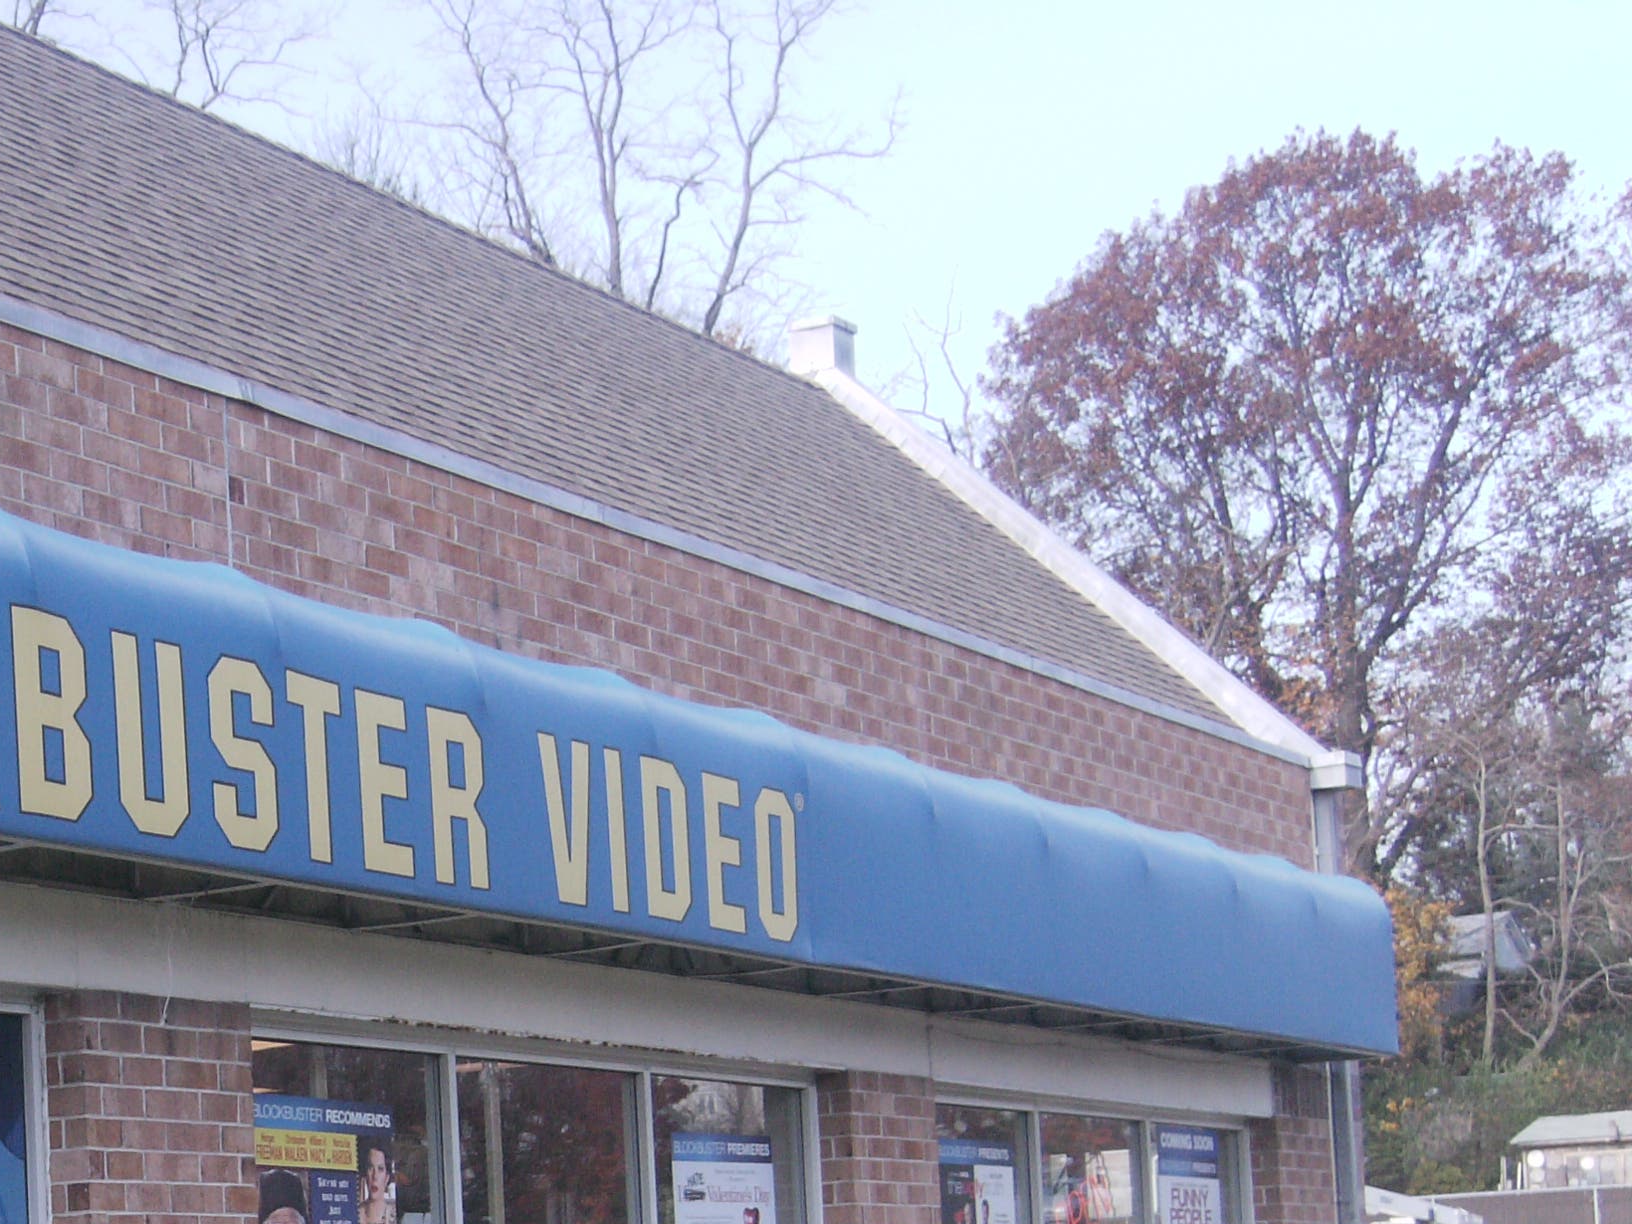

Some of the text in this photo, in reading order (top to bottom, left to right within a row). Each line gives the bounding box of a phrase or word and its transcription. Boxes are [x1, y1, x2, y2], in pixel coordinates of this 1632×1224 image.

[536, 730, 799, 943] VIDEO
[254, 1103, 391, 1128] BLOCKBUSTER RECOMMENDS
[1171, 1187, 1209, 1208] FUNNY
